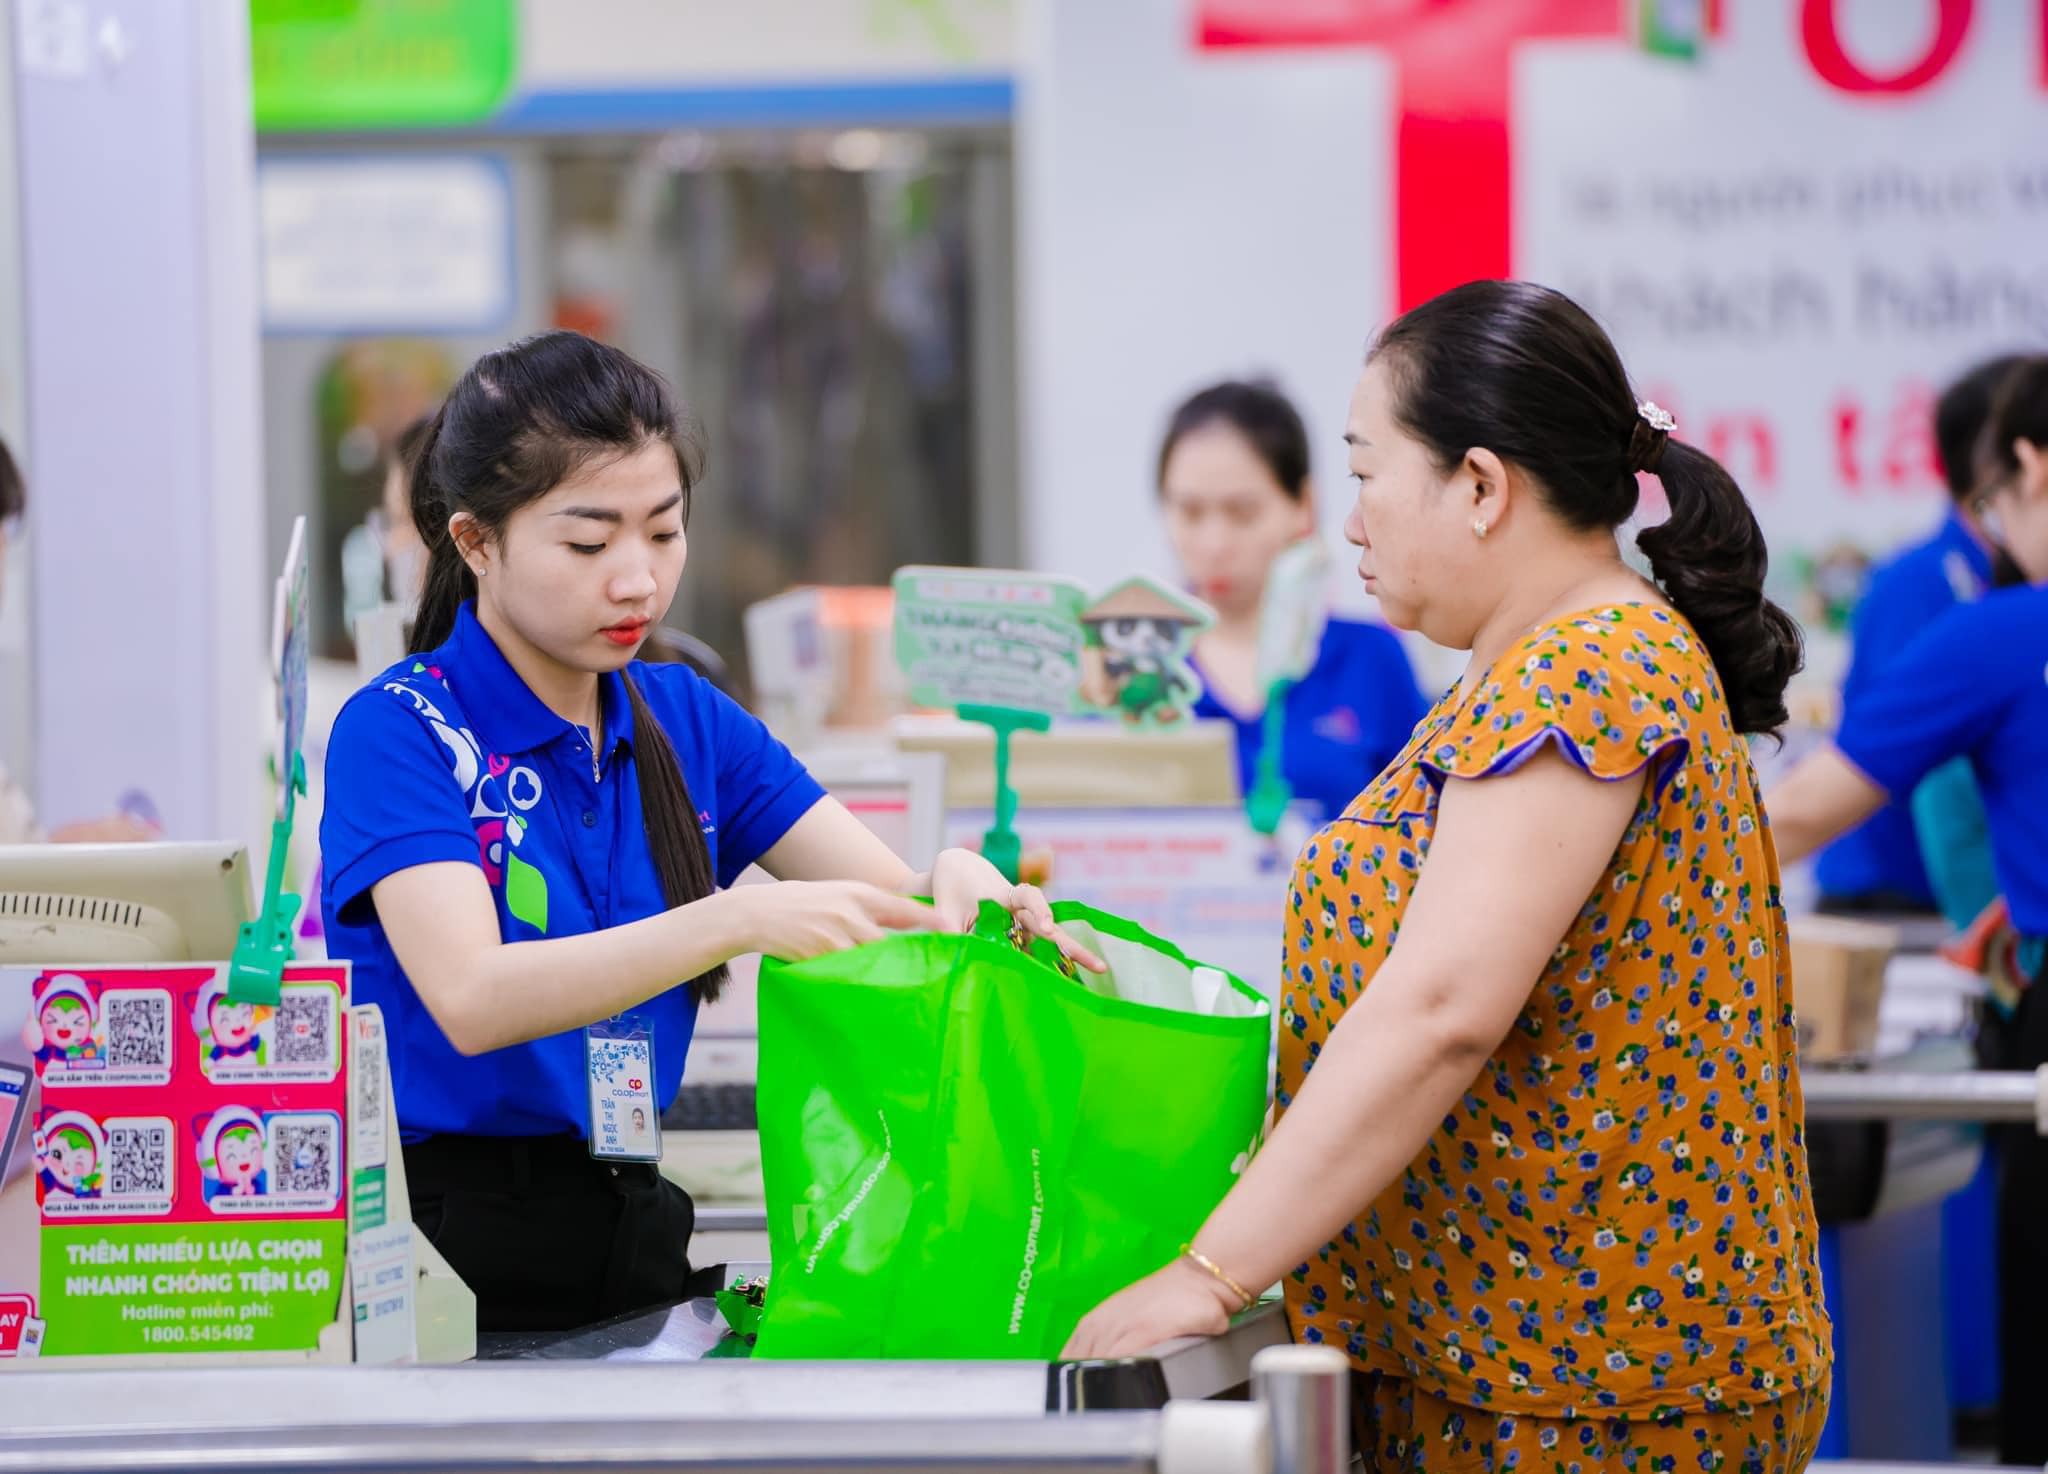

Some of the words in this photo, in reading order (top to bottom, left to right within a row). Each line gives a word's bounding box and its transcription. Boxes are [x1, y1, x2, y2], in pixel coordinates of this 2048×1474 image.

[65, 1238, 129, 1265] THÊM
[208, 1239, 253, 1266] LỰA
[258, 1239, 323, 1265] CHỌN
[66, 1275, 147, 1296] NHANH
[152, 1268, 233, 1293] CHÓNG
[238, 1266, 288, 1297] TIỆN
[294, 1269, 331, 1295] LỢI
[121, 1304, 186, 1321] Hotline
[141, 1325, 255, 1343] 1800.545492
